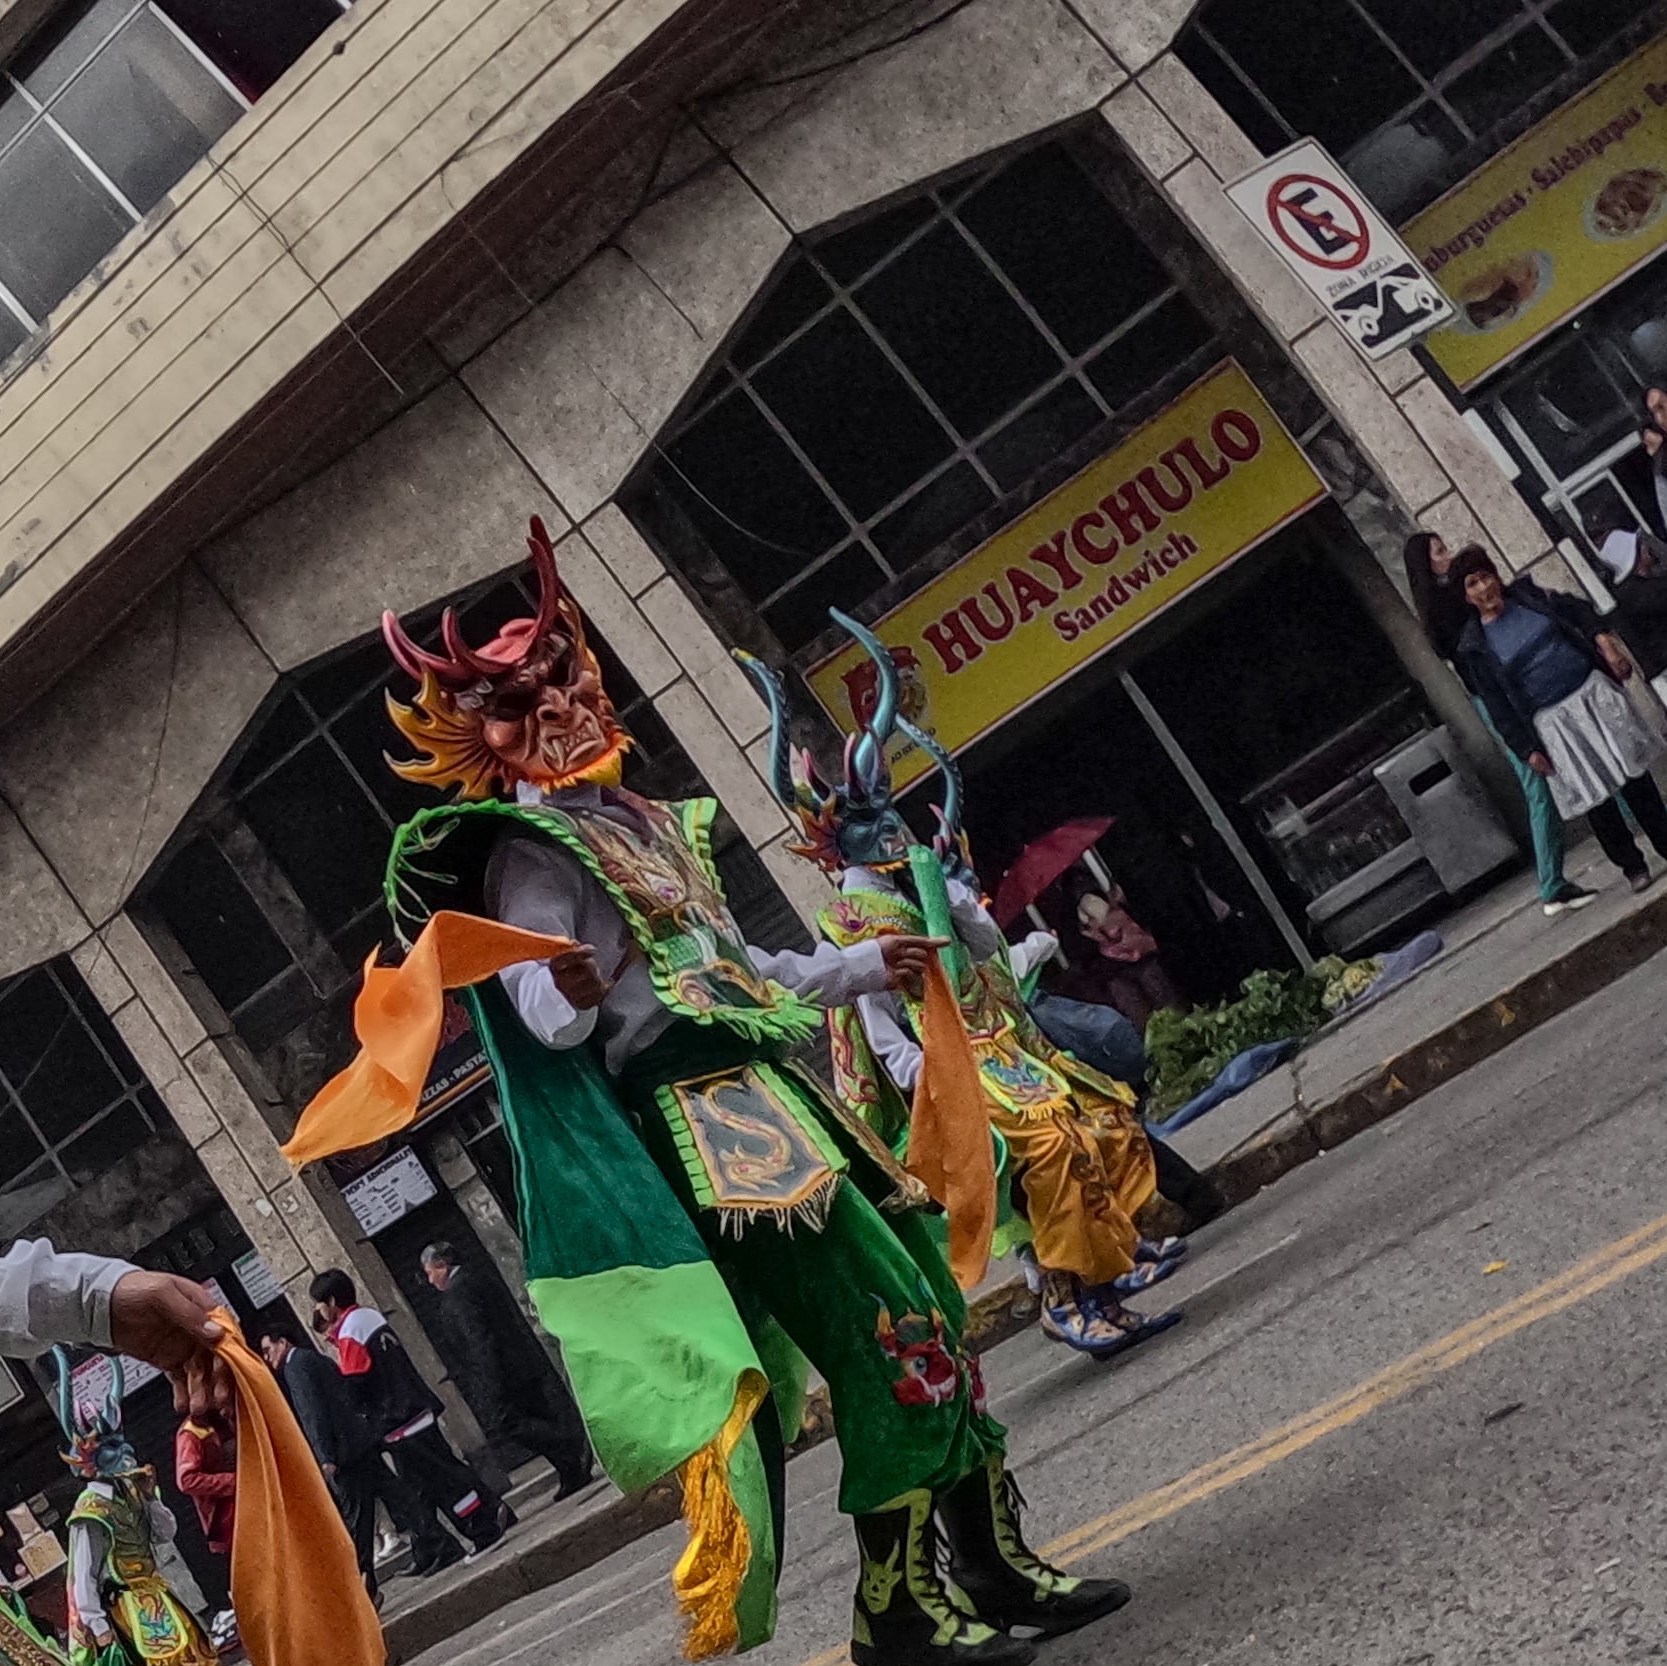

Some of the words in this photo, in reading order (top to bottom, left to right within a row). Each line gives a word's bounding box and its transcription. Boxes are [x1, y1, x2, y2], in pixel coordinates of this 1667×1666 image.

[1284, 188, 1348, 255] E
[920, 407, 1262, 675] HUAYCHULO
[1053, 530, 1199, 641] Sandwich
